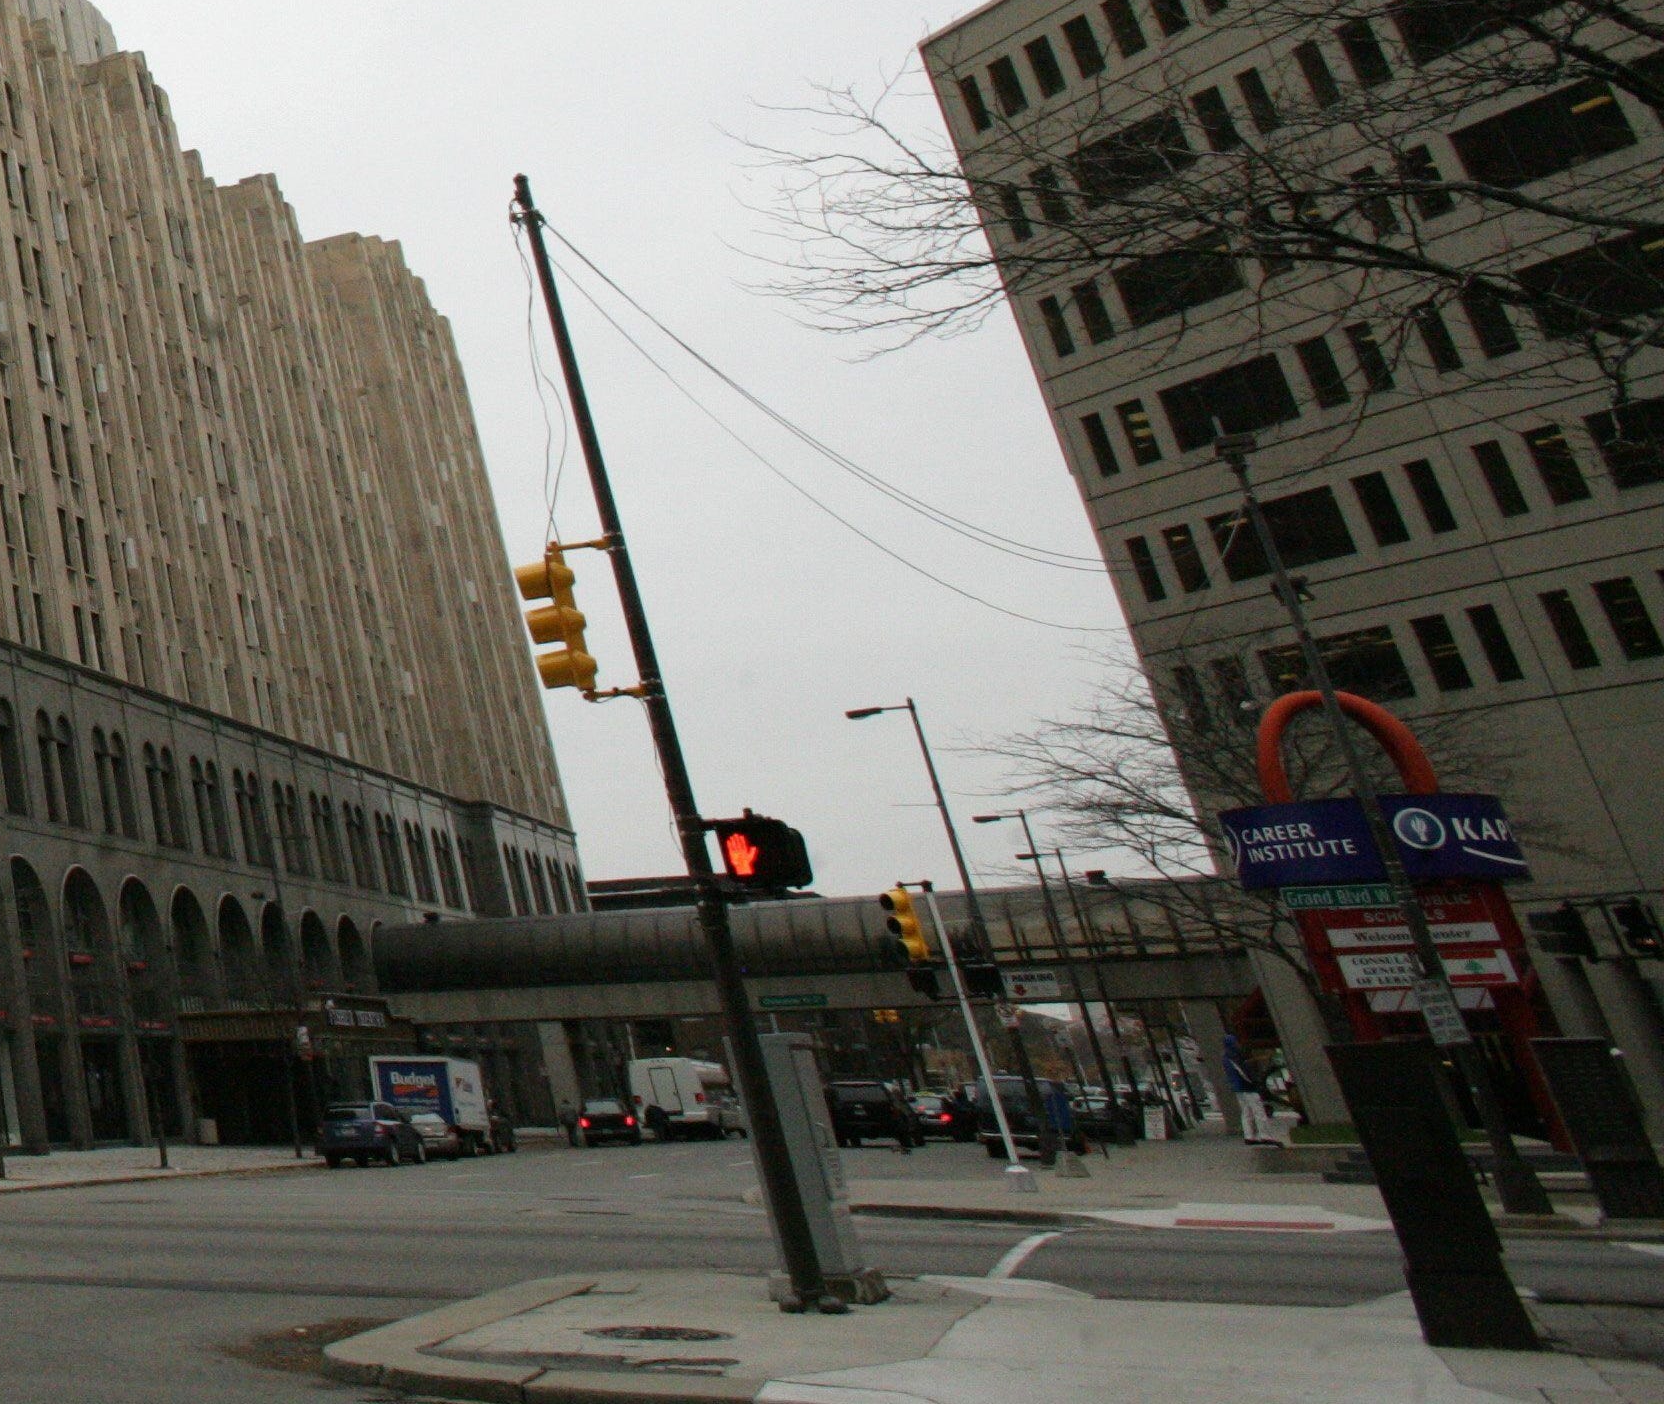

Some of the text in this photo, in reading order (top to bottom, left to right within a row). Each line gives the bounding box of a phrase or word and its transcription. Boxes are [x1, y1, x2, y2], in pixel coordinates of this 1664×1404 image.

[1241, 822, 1315, 845] CAREER
[1247, 838, 1357, 864] INSTITUTE
[1287, 887, 1390, 906] Grand Blvd W
[1420, 893, 1471, 907] UBLIC
[1354, 929, 1471, 942] Welcom enter
[390, 1071, 437, 1088] Budget
